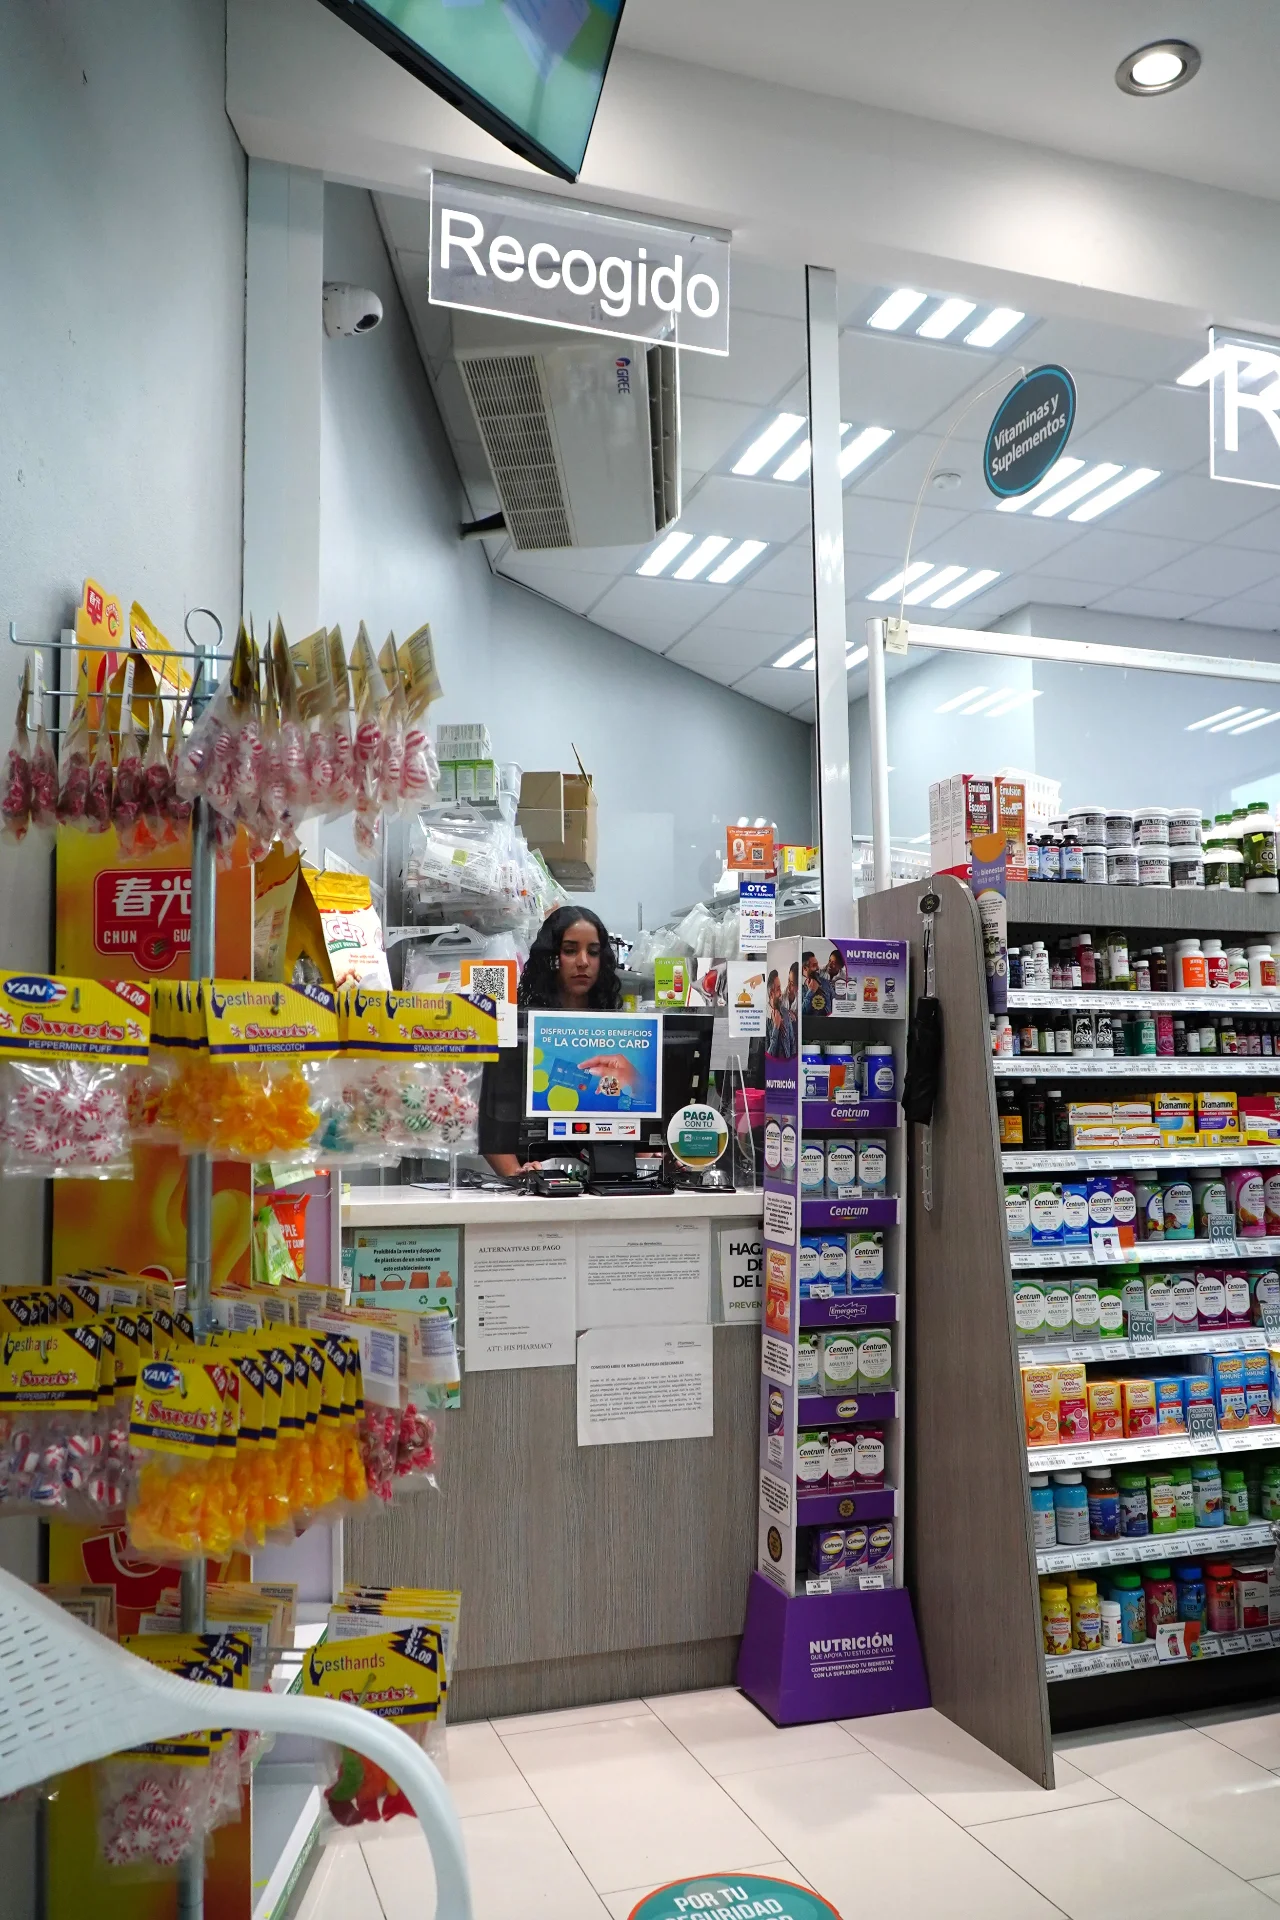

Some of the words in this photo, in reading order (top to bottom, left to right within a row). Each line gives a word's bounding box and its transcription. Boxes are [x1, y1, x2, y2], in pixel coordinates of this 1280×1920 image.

[441, 208, 720, 318] Recogido
[617, 369, 630, 393] GREE
[994, 402, 1050, 452] Vitaminas
[1050, 392, 1060, 415] y
[992, 412, 1066, 476] Suplementos
[969, 783, 989, 793] Emulsión
[1000, 786, 1021, 796] Emulsión
[969, 794, 974, 802] de
[969, 803, 986, 812] Escocia
[981, 866, 1005, 876] bienestar
[846, 950, 899, 959] NUTRICIÓN
[7, 983, 46, 996] YAN
[114, 981, 146, 1006] $1.09
[304, 984, 330, 1005] $1.09
[210, 987, 286, 1019] besthands
[468, 994, 492, 1011] $1.09
[20, 1013, 124, 1040] Sweets
[245, 1024, 307, 1039] Sweets
[411, 1025, 468, 1040] Sweets
[607, 1029, 652, 1037] BENEFICIOS
[28, 1040, 86, 1052] PEPPERMINT
[89, 1044, 112, 1053] PUFF
[248, 1043, 305, 1052] BUTTERSCOTCH
[554, 1038, 568, 1047] LA
[571, 1038, 616, 1048] COMBO
[619, 1039, 650, 1048] CARD
[766, 1079, 796, 1090] NUTRICIÓN
[831, 1108, 869, 1117] Centrum
[1158, 1101, 1192, 1110] Dramamine
[1201, 1101, 1235, 1109] Dramamine
[684, 1112, 714, 1120] PAGA
[829, 1206, 869, 1216] Centrum
[1212, 1226, 1232, 1235] OTC
[77, 1285, 96, 1306] $1.09
[10, 1301, 28, 1321] $1.09
[830, 1306, 865, 1315] Emergen-C
[115, 1316, 135, 1337] $1.09
[1132, 1323, 1152, 1332] OTC
[74, 1328, 95, 1350] $1.09
[324, 1341, 345, 1366] $1.09
[20, 1370, 69, 1386] Sweets
[143, 1368, 168, 1383] YAN
[241, 1359, 261, 1386] $1.09
[147, 1400, 208, 1429] Sweets
[1192, 1419, 1213, 1429] OTC
[152, 1427, 195, 1442] BUTTERSCOTCH
[810, 1632, 893, 1653] NUTRICIÓN
[405, 1645, 432, 1664] $1.09
[309, 1647, 385, 1686] besthands
[811, 1663, 859, 1672] COMPLEMENTANDO
[834, 1667, 877, 1677] SUPLEMENTACIÓN
[381, 1707, 404, 1716] CANDY
[673, 1892, 719, 1912] POR
[717, 1886, 748, 1903] TU
